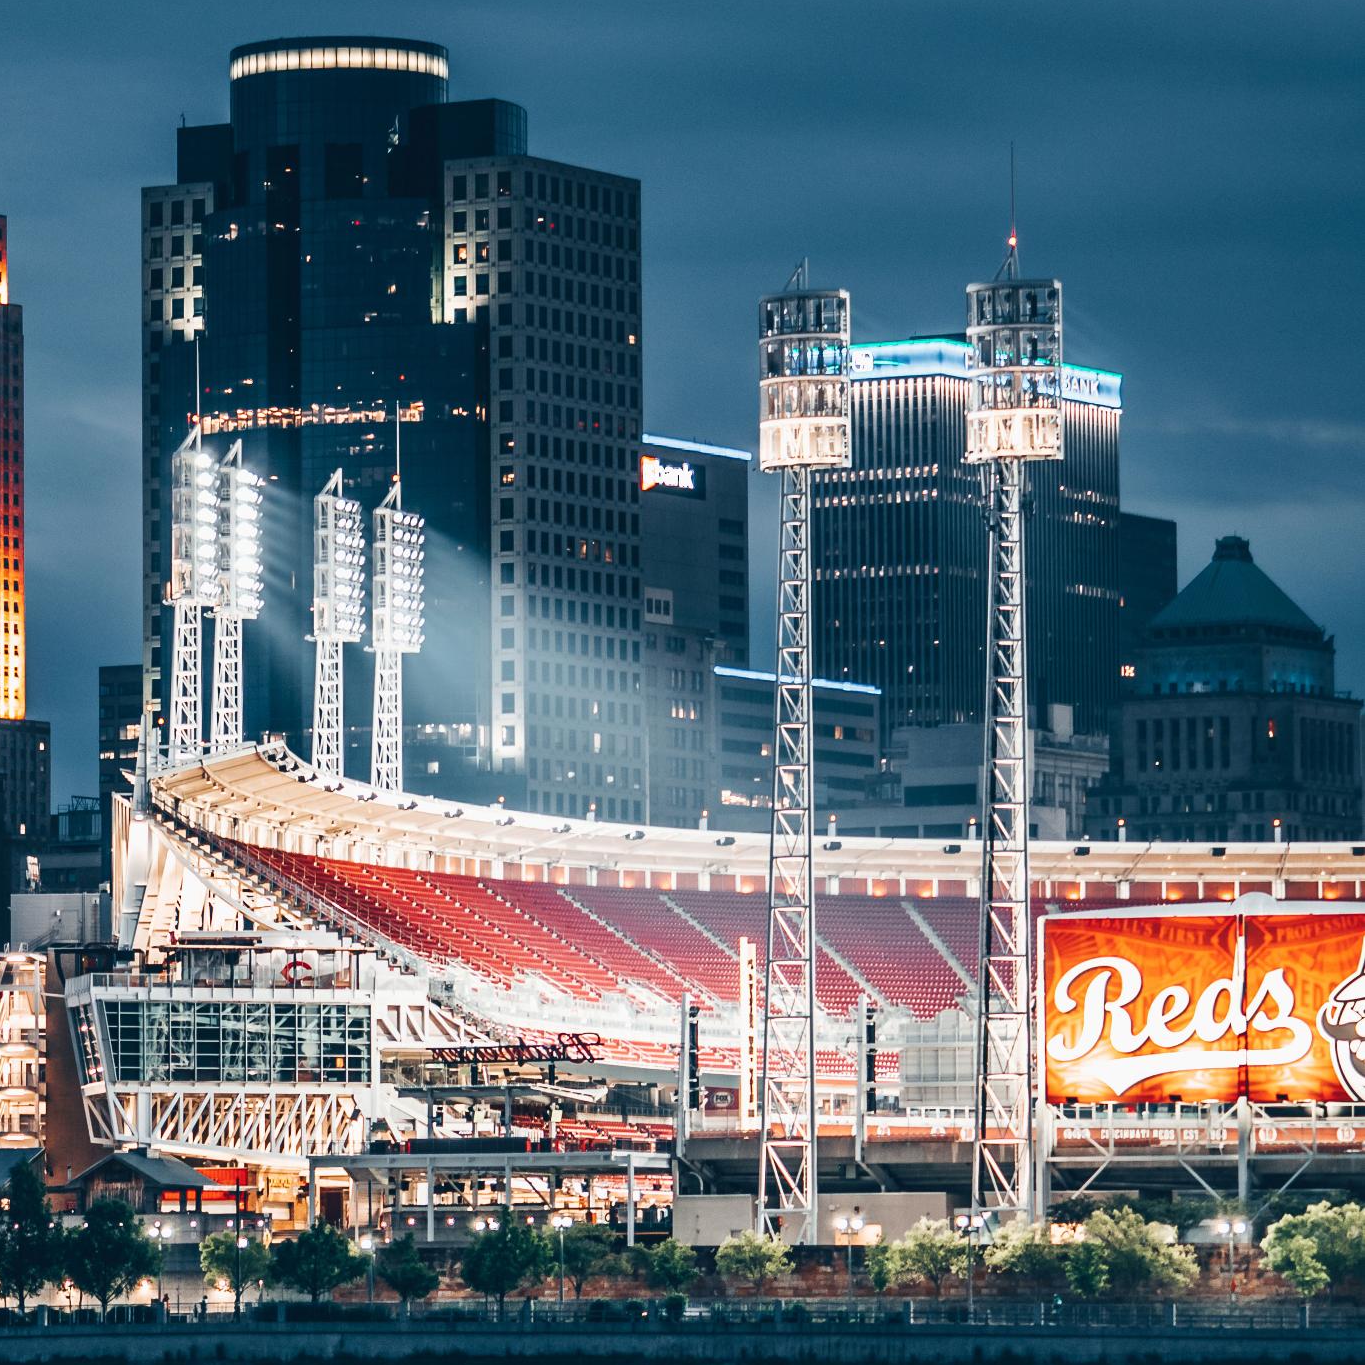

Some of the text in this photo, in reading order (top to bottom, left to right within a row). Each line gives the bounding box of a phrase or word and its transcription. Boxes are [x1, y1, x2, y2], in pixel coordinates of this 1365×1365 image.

[1046, 935, 1314, 1065] Reds
[716, 1094, 729, 1102] FOX
[1100, 1129, 1150, 1140] CICINNATI
